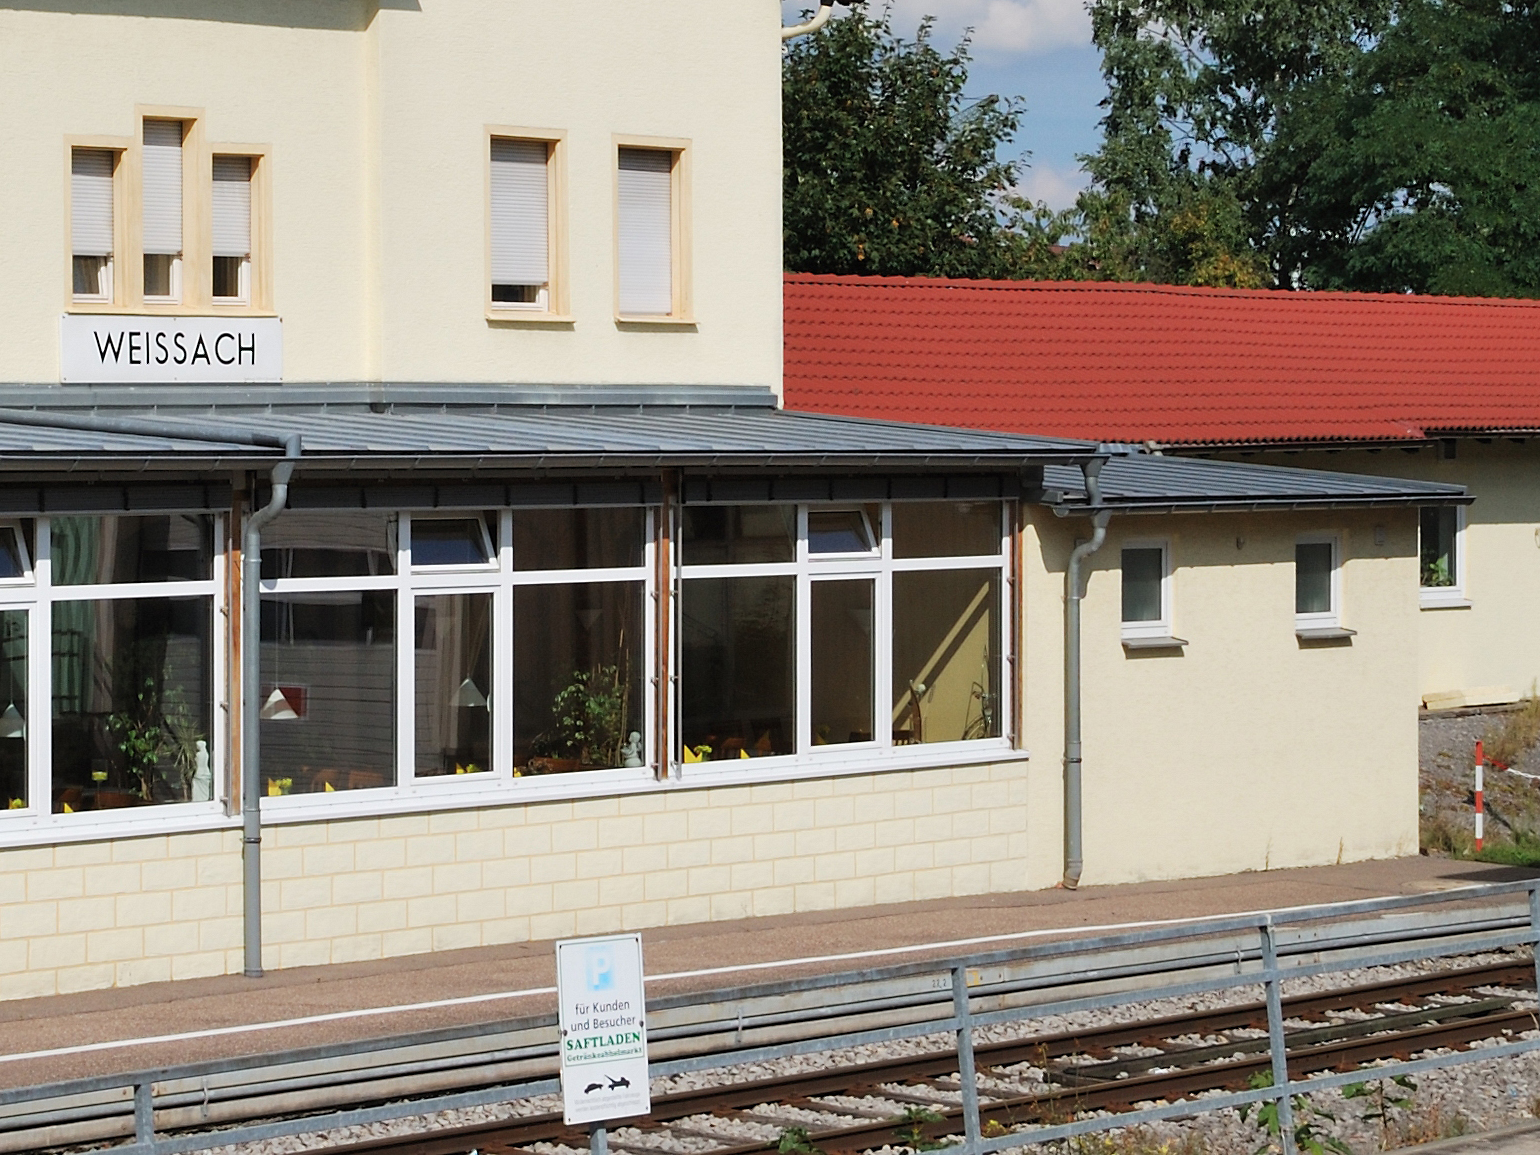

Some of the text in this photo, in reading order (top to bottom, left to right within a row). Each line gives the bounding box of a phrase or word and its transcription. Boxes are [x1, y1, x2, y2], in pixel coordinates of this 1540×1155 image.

[93, 330, 256, 366] WEISSACH
[575, 999, 631, 1016] für Kunden
[570, 1014, 637, 1032] und Besucher
[566, 1030, 642, 1051] SAFTLADEN
